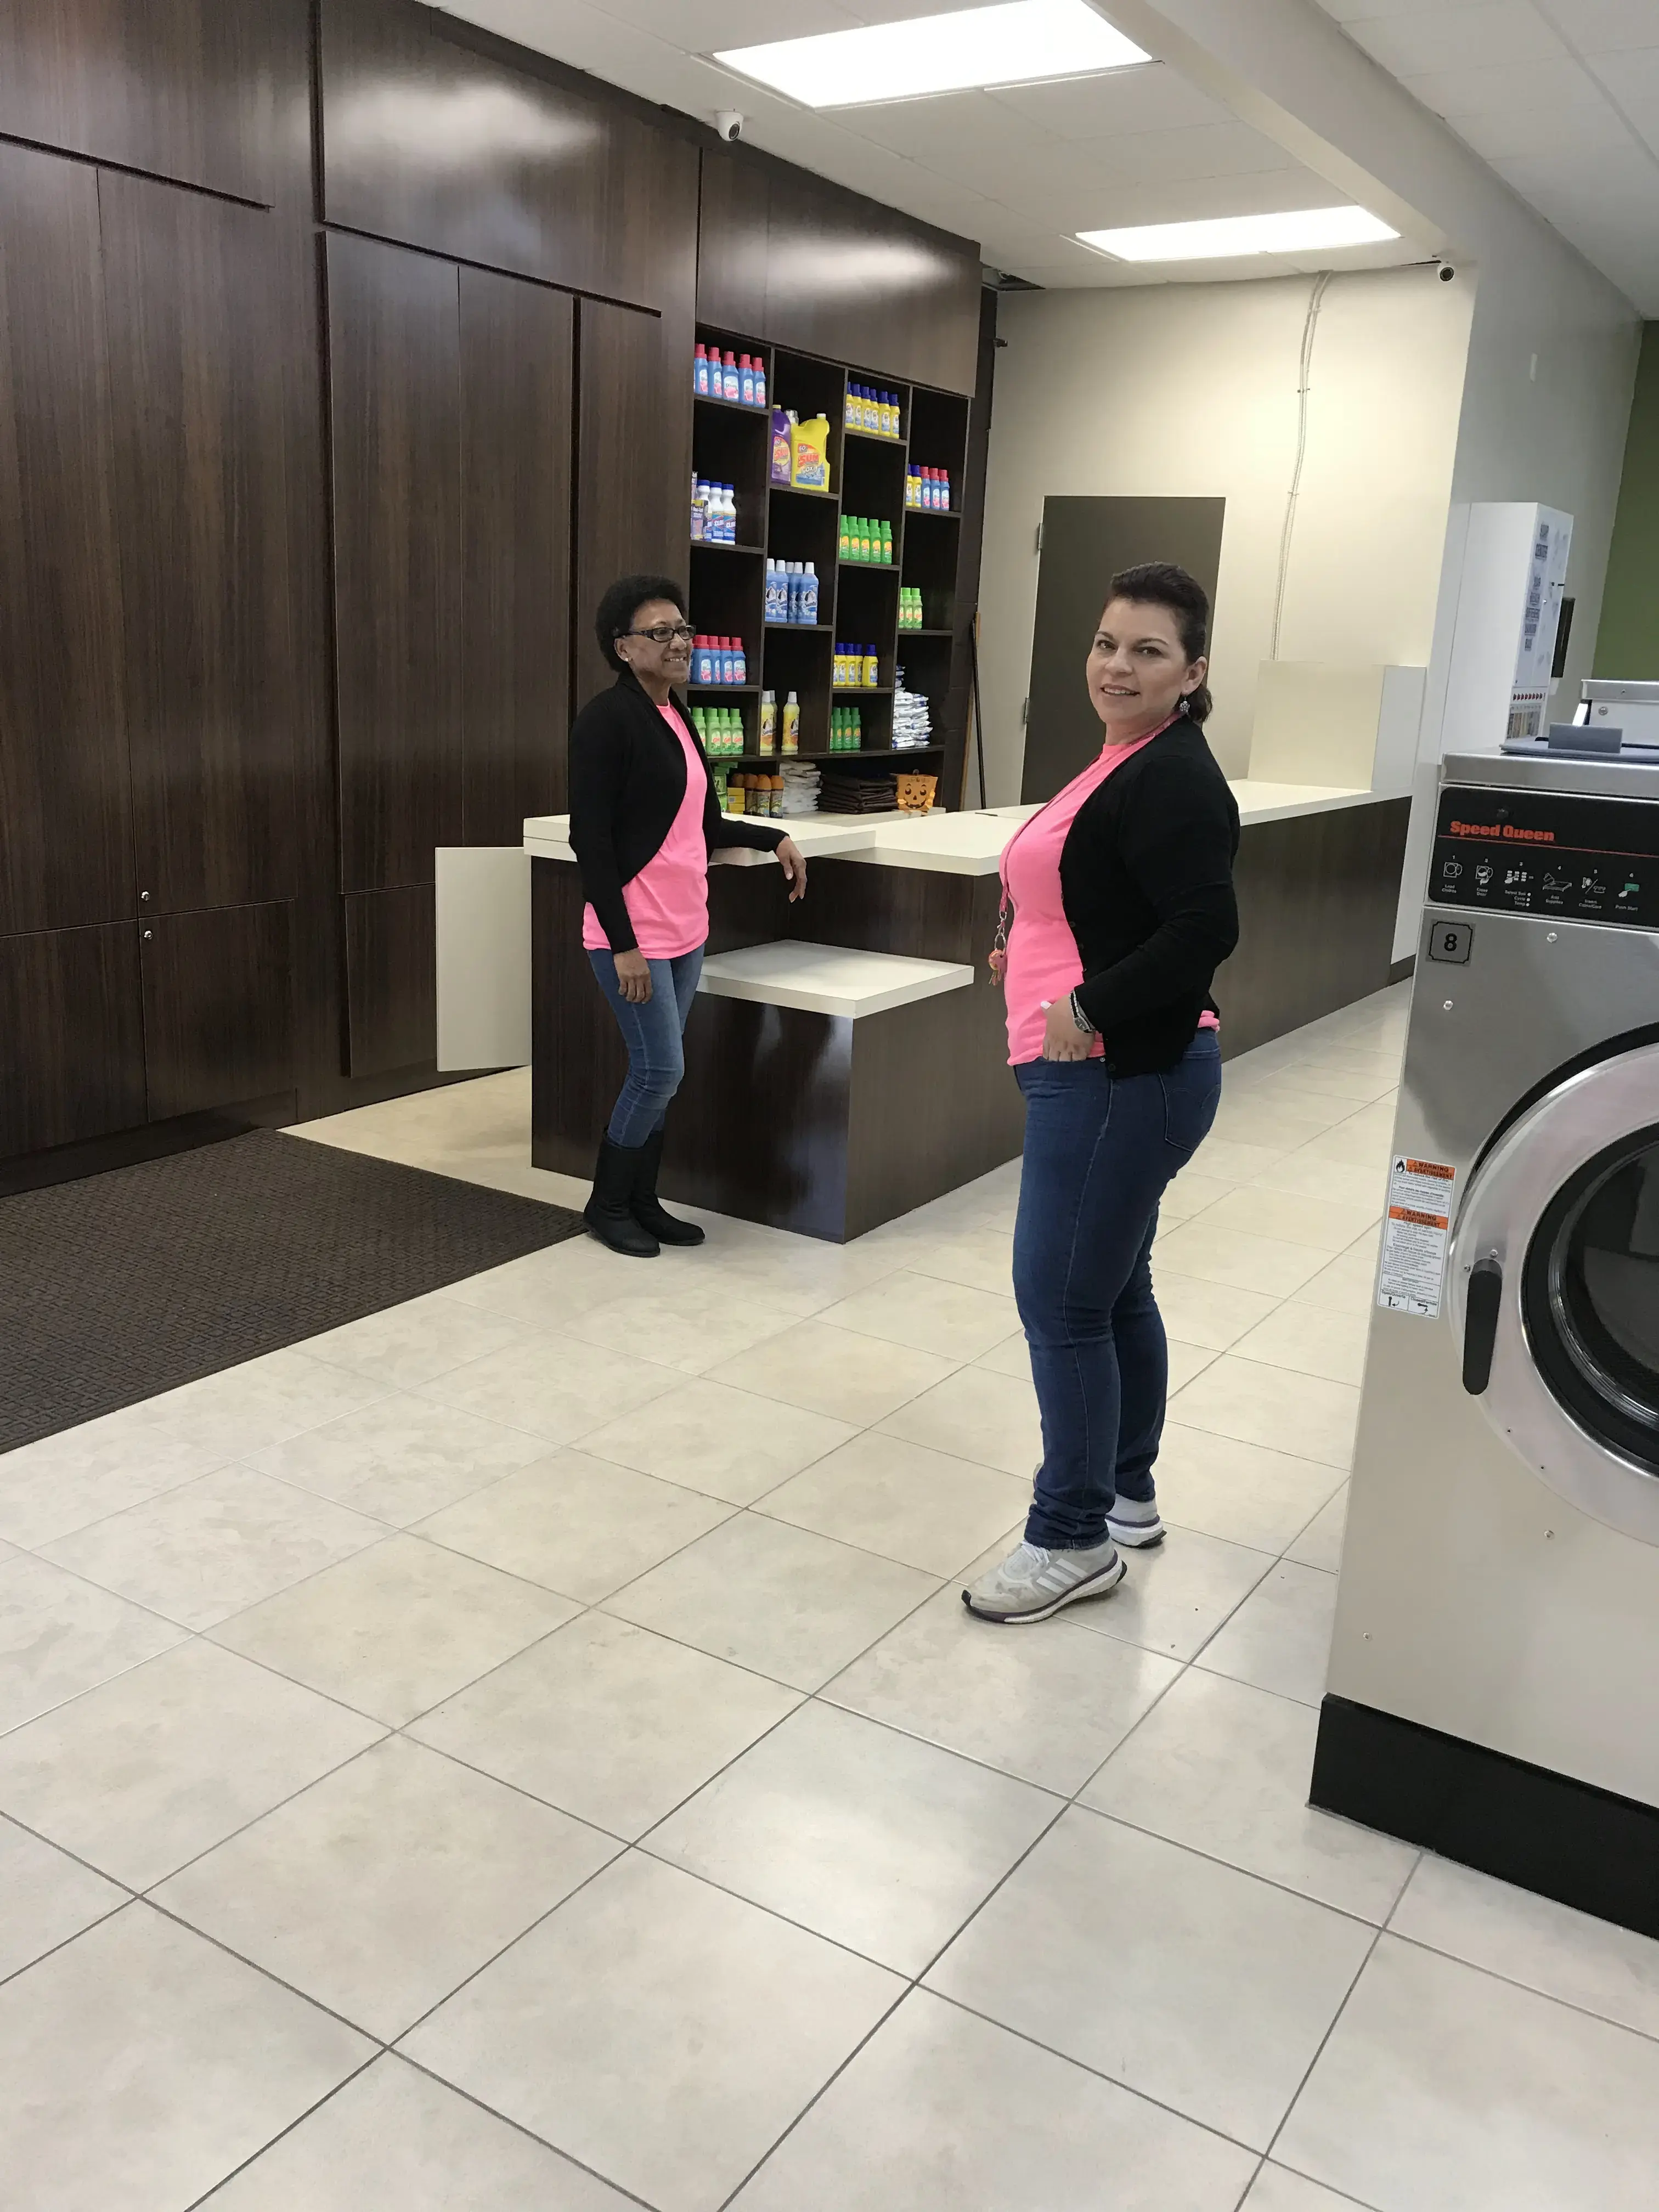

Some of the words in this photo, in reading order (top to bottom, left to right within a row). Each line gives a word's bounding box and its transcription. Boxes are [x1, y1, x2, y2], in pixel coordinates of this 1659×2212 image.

[1450, 821, 1500, 836] Speed
[1503, 825, 1555, 841] Queen
[1444, 933, 1457, 951] 8
[1418, 1162, 1449, 1172] WARNING
[1407, 1210, 1436, 1221] WARNING
